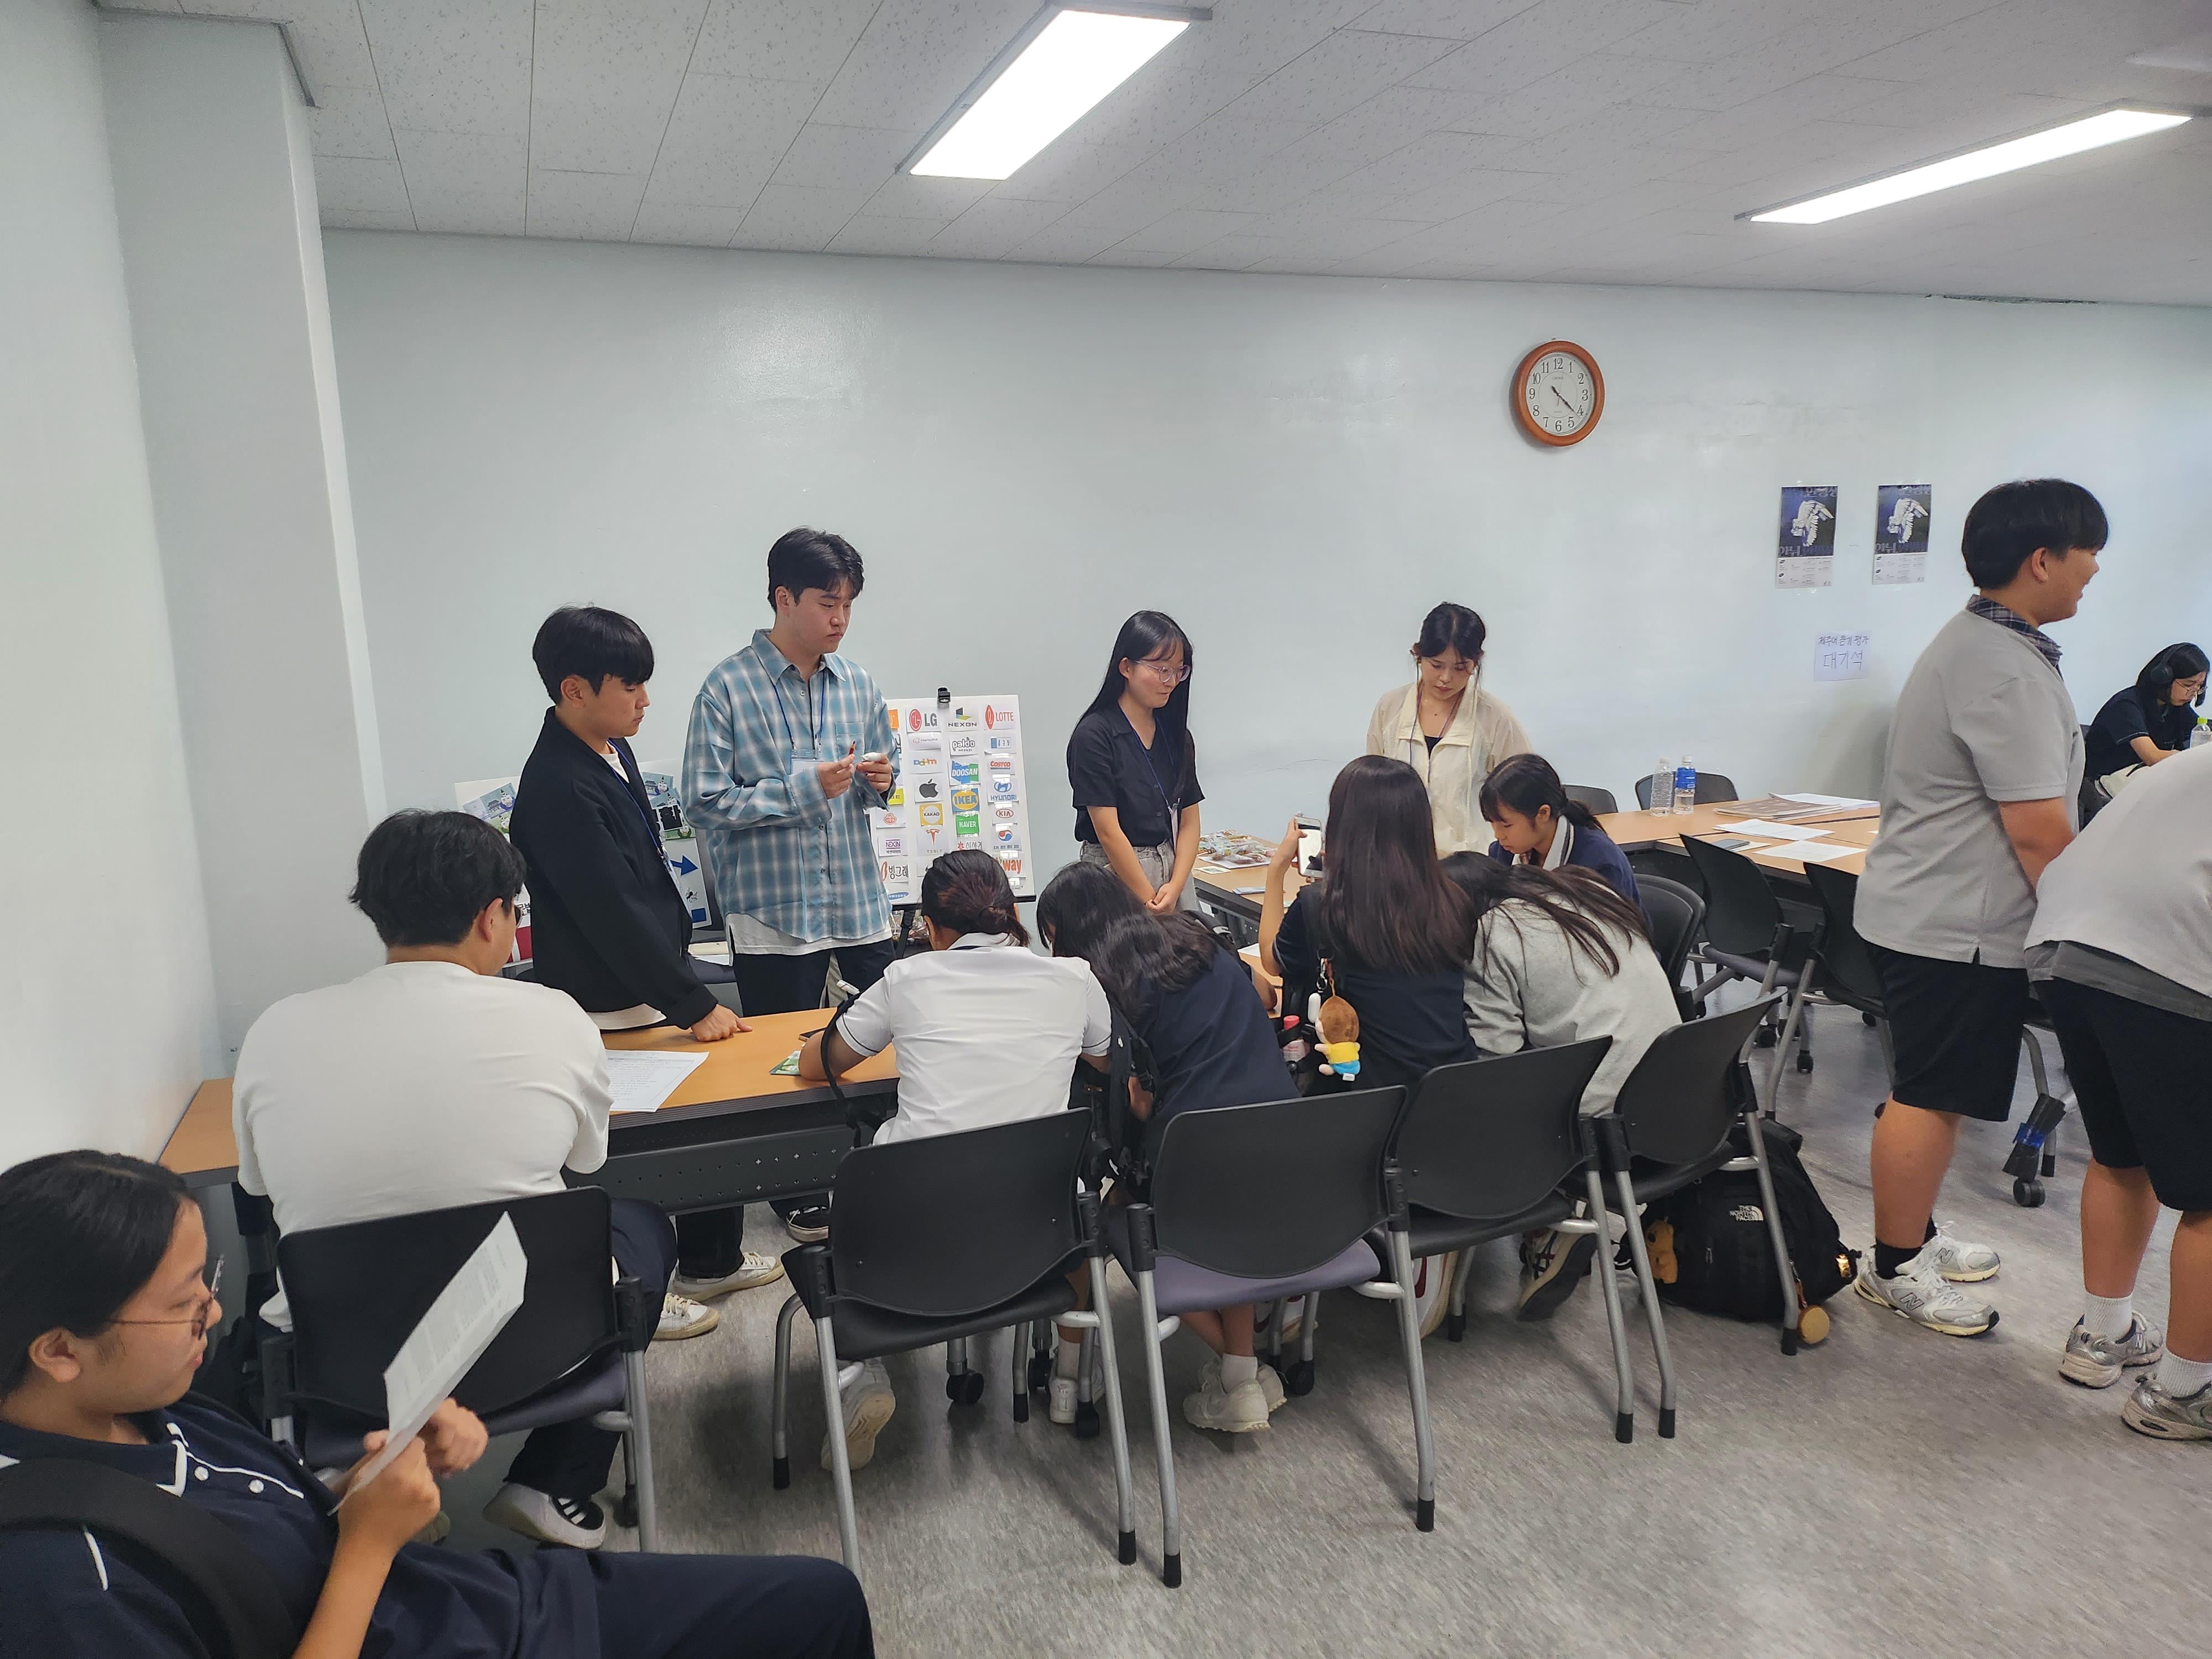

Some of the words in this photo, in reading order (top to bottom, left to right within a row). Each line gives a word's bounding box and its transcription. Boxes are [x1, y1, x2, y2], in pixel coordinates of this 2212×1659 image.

[1542, 362, 1549, 373] 11
[1553, 358, 1563, 369] 12
[1568, 362, 1573, 373] 1
[1532, 373, 1541, 384] 10
[1578, 373, 1584, 384] 2
[1529, 388, 1535, 400] 9
[1582, 389, 1588, 401] 3
[1533, 405, 1540, 416] 8
[1577, 405, 1584, 416] 4
[1543, 416, 1549, 427] 7
[1555, 420, 1562, 432] 6
[1568, 416, 1574, 428] 5
[1854, 635, 1870, 646] 평가
[1823, 649, 1863, 670] 대기석
[924, 713, 937, 727] LG
[995, 712, 1014, 722] LOTTE
[952, 737, 975, 752] paldo
[952, 768, 978, 777] DOOSAN
[955, 795, 977, 805] IKEA
[889, 864, 909, 880] 빙그레
[1900, 1292, 1925, 1311] N
